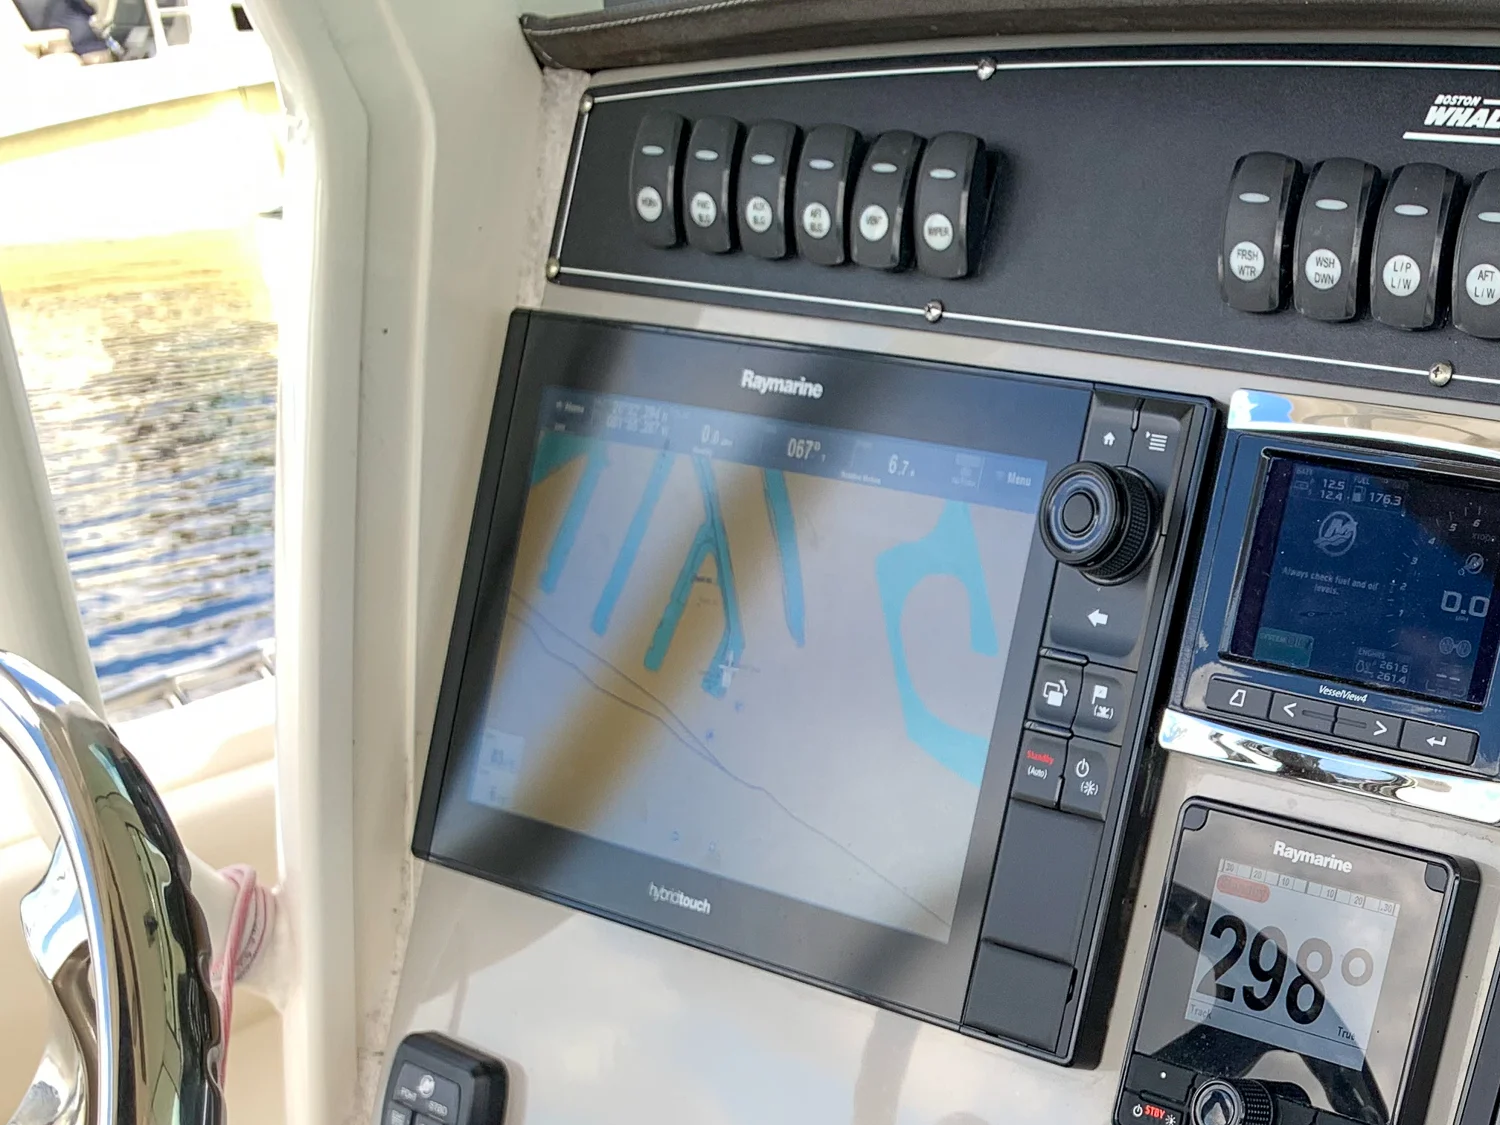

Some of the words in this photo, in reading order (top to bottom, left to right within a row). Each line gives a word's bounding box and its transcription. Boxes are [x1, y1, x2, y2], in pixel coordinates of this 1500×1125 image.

[1434, 94, 1482, 107] BOSTON
[1236, 248, 1259, 262] FRSH
[1237, 263, 1257, 277] WTR
[1315, 256, 1336, 270] WSH
[1314, 271, 1335, 285] DWN
[1477, 270, 1495, 283] AFT
[740, 368, 824, 400] Raymarine
[1007, 471, 1033, 488] Menu
[1323, 479, 1347, 491] 12.5
[1320, 489, 1344, 502] 12.4
[1369, 491, 1403, 507] 176.3
[1448, 523, 1458, 532] 5
[1472, 518, 1481, 528] 6
[1428, 536, 1437, 545] 4
[1410, 556, 1419, 566] 3
[1281, 566, 1309, 580] Always
[1310, 572, 1333, 584] check
[1335, 575, 1351, 586] fuel
[1351, 579, 1367, 589] and
[1399, 582, 1408, 591] 2
[1440, 589, 1491, 618] 0.0
[1379, 660, 1410, 674] 261.6
[1376, 671, 1407, 686] 261.4
[1027, 765, 1048, 780] (Auto)
[1272, 840, 1353, 874] Raymarine
[1253, 870, 1263, 880] 20
[1281, 876, 1290, 887] 10
[1326, 887, 1335, 898] 10
[1353, 896, 1364, 905] 20
[648, 879, 712, 917] hybridtouch
[1189, 1003, 1213, 1020] Track
[1337, 1025, 1356, 1042] True
[1144, 1104, 1166, 1120] STBY
